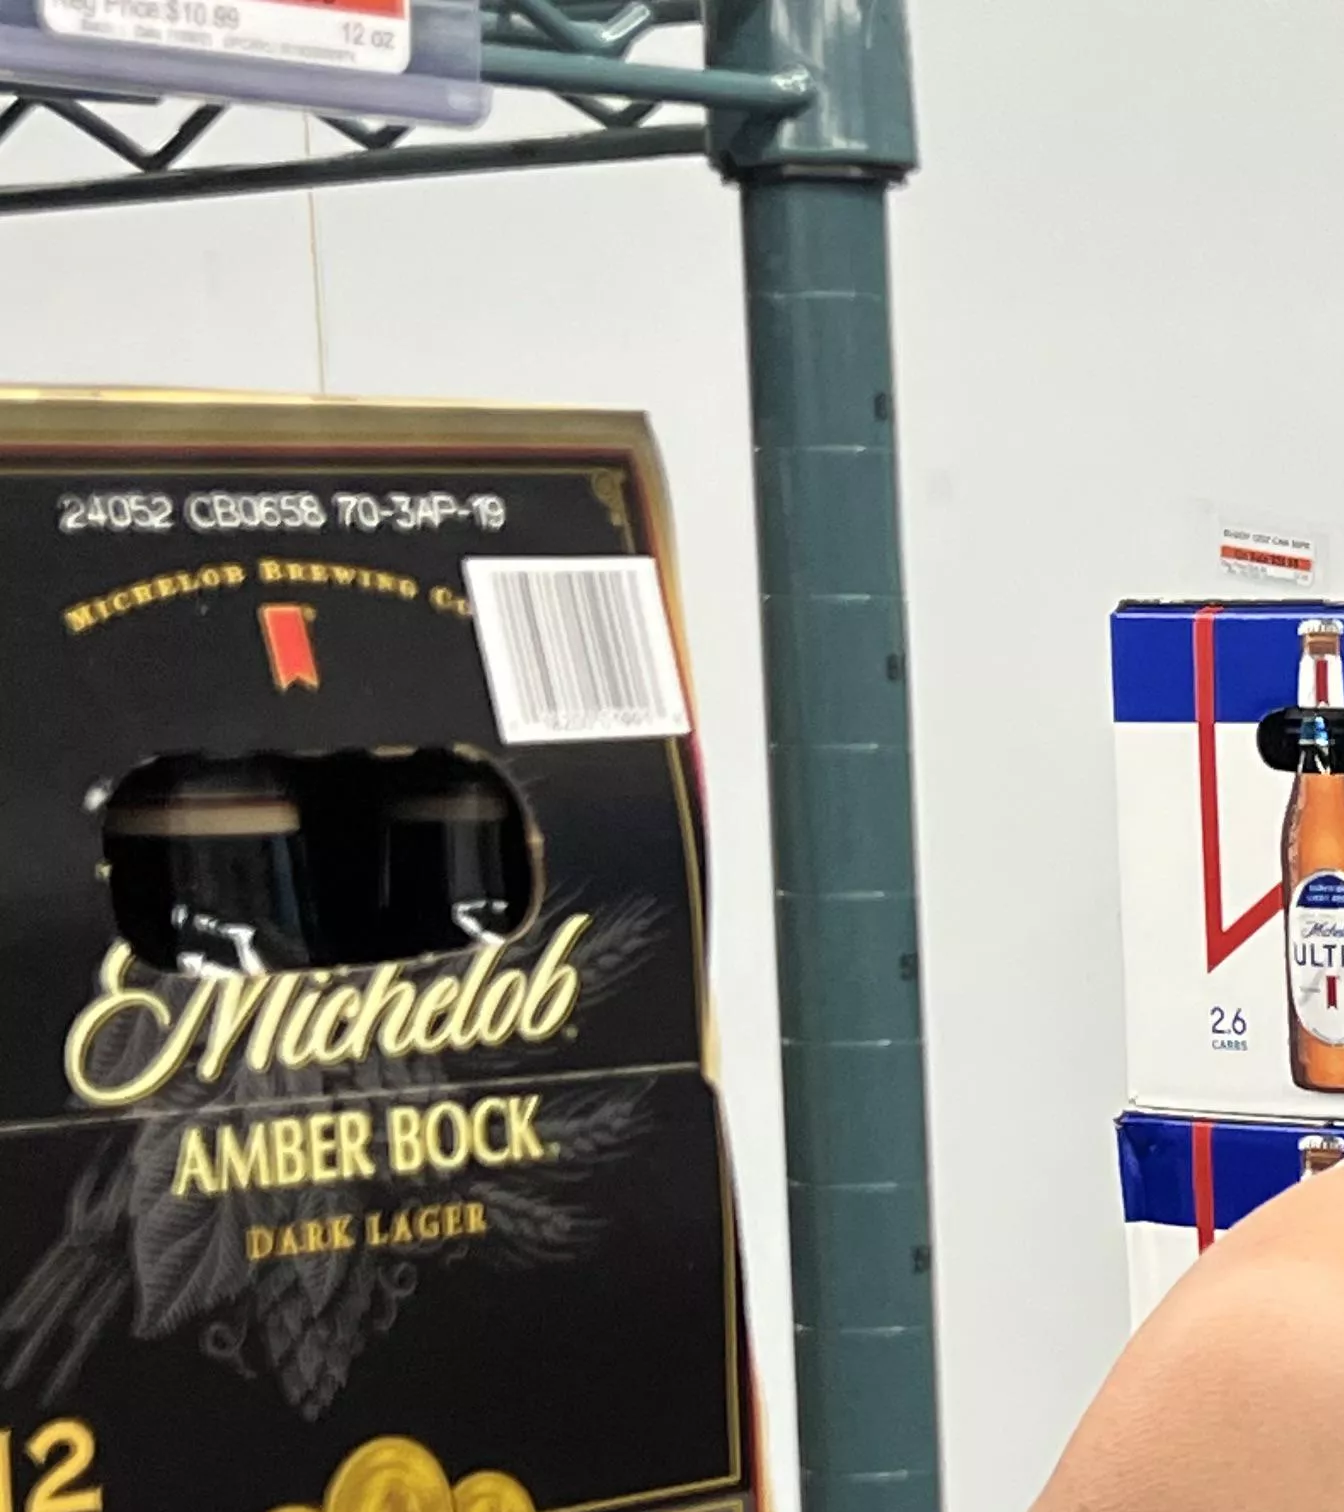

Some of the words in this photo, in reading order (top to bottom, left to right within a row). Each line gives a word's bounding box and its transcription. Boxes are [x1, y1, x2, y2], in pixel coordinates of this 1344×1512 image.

[59, 492, 173, 532] 24052
[62, 560, 246, 634] MICHELOB
[256, 556, 420, 600] BREWING
[63, 912, 592, 1103] Michelob
[1209, 1006, 1248, 1037] 2.6
[1210, 1039, 1249, 1052] CARBS
[169, 1109, 376, 1199] AMBER
[245, 1219, 357, 1262] DARK
[365, 1201, 488, 1250] LAGER
